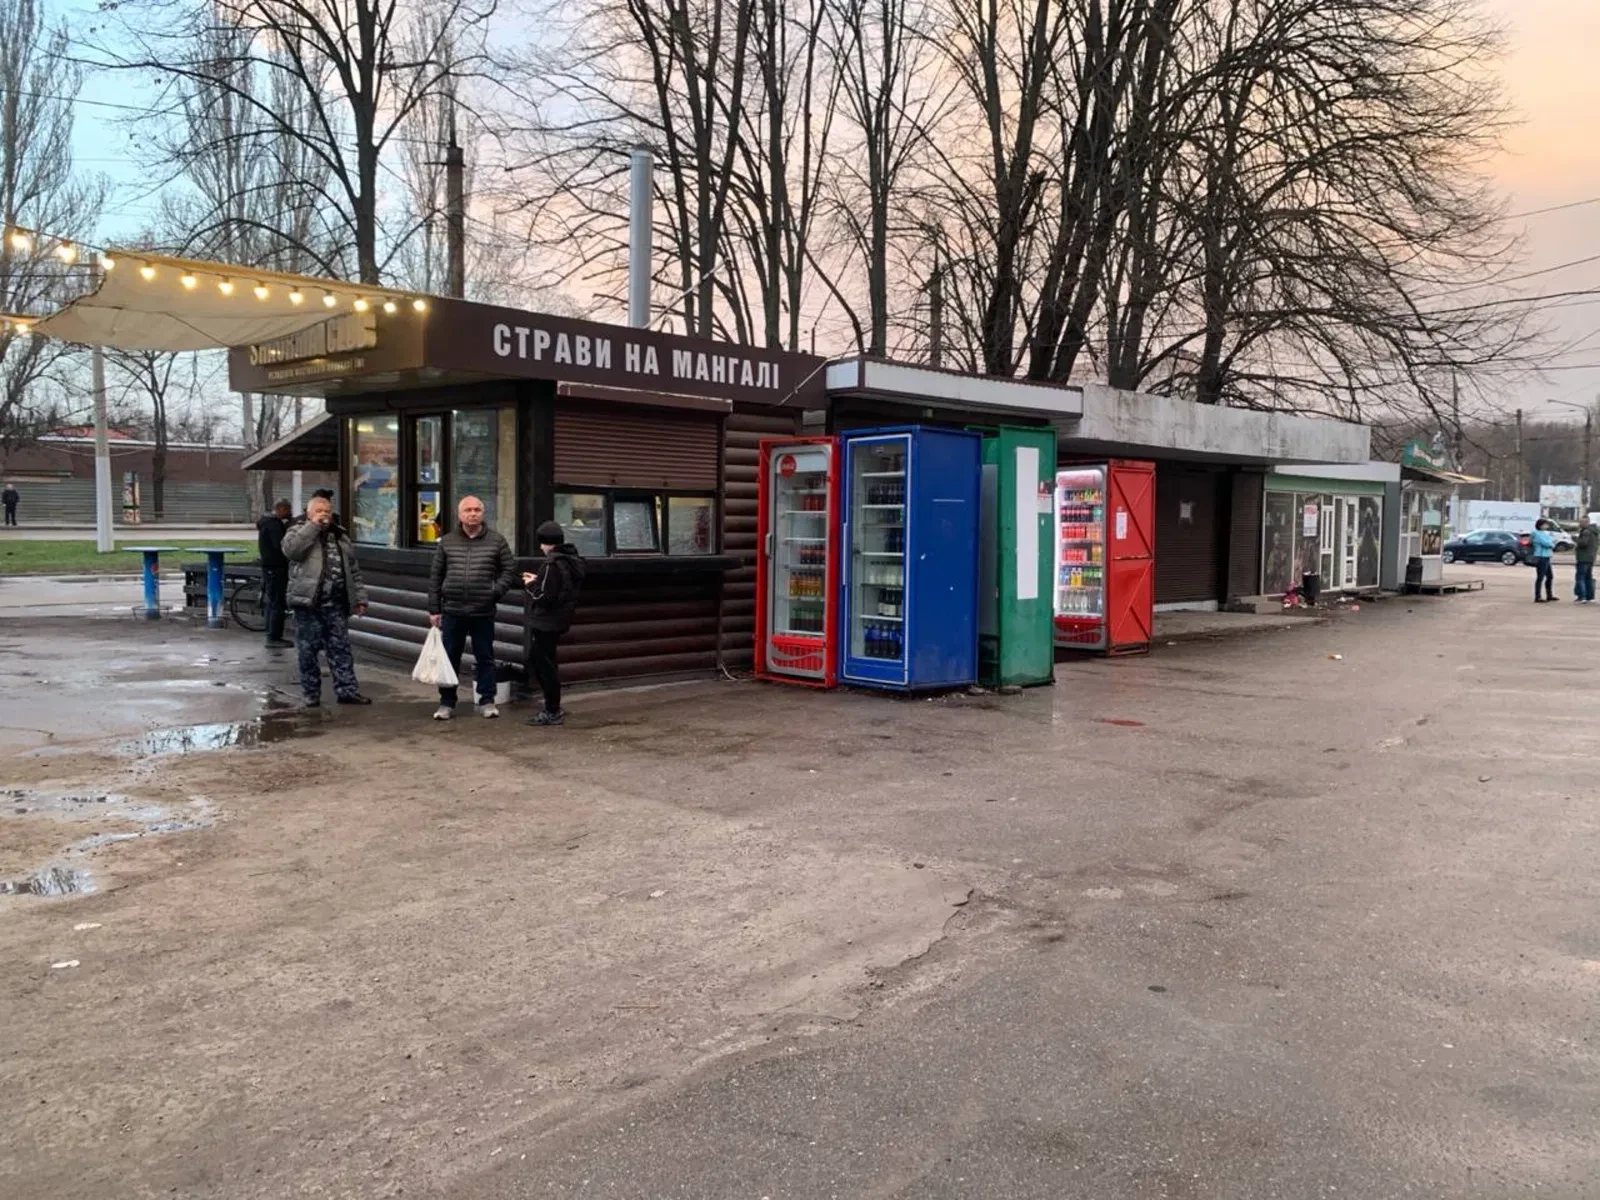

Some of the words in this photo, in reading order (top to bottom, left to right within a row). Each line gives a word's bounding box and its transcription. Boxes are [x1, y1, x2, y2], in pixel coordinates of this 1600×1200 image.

[493, 323, 611, 369] СТРАВИ
[625, 342, 659, 375] НА
[672, 350, 779, 389] МАНГАЛІ
